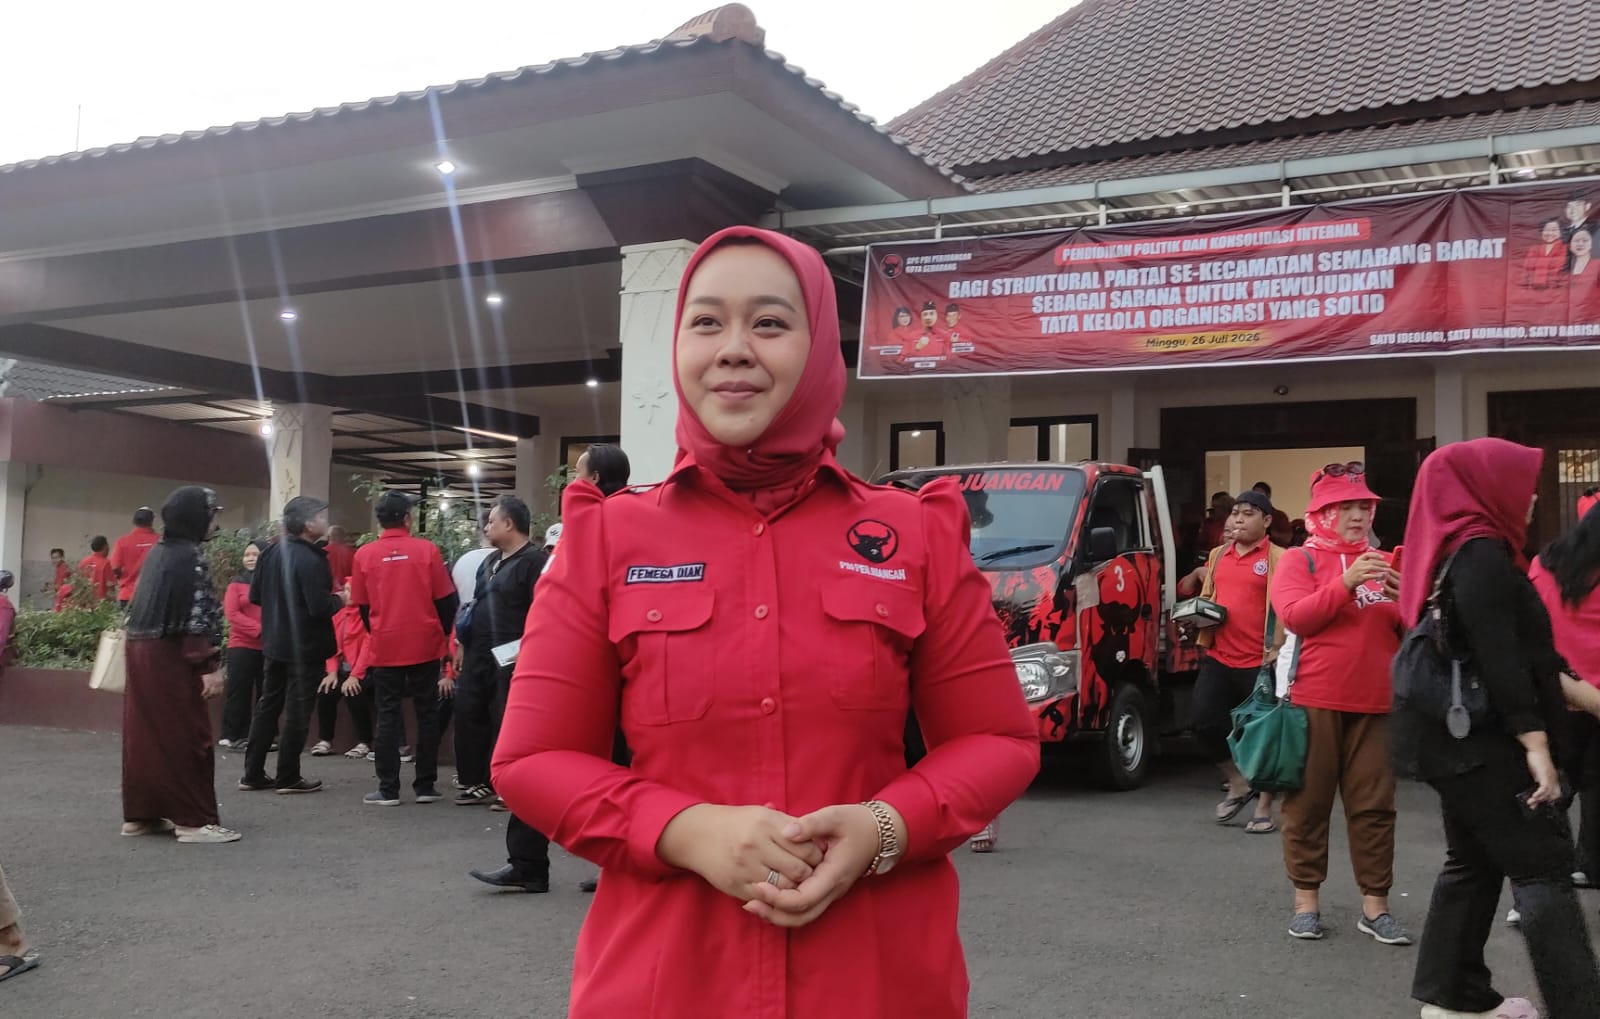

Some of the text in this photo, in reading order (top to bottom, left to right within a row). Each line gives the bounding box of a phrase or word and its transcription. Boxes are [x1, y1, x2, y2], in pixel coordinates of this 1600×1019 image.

[1062, 223, 1360, 260] PENDIDIKAN POLITIK DAN KONSOLIDASI INTERNAL
[949, 237, 1506, 299] BAGI STRUKTURAL PARTAI SE-KECAMATAN SEMARANG BARAT
[1032, 269, 1395, 313] SEBAGAI SARANA UNTUK MEWUJUDKAN
[1040, 294, 1385, 334] TATA KELOLA ORGANISASI YANG SOLID
[1192, 336, 1205, 345] 26
[1208, 333, 1228, 343] Juli
[1231, 332, 1260, 342] 2026
[1369, 324, 1600, 346] SATU IDEOLOGI, SATU KOMANDO, SATU BARISA
[960, 472, 1065, 491] JUANGAN
[630, 566, 702, 580] FEMEGA DIAN
[1115, 565, 1125, 592] 3
